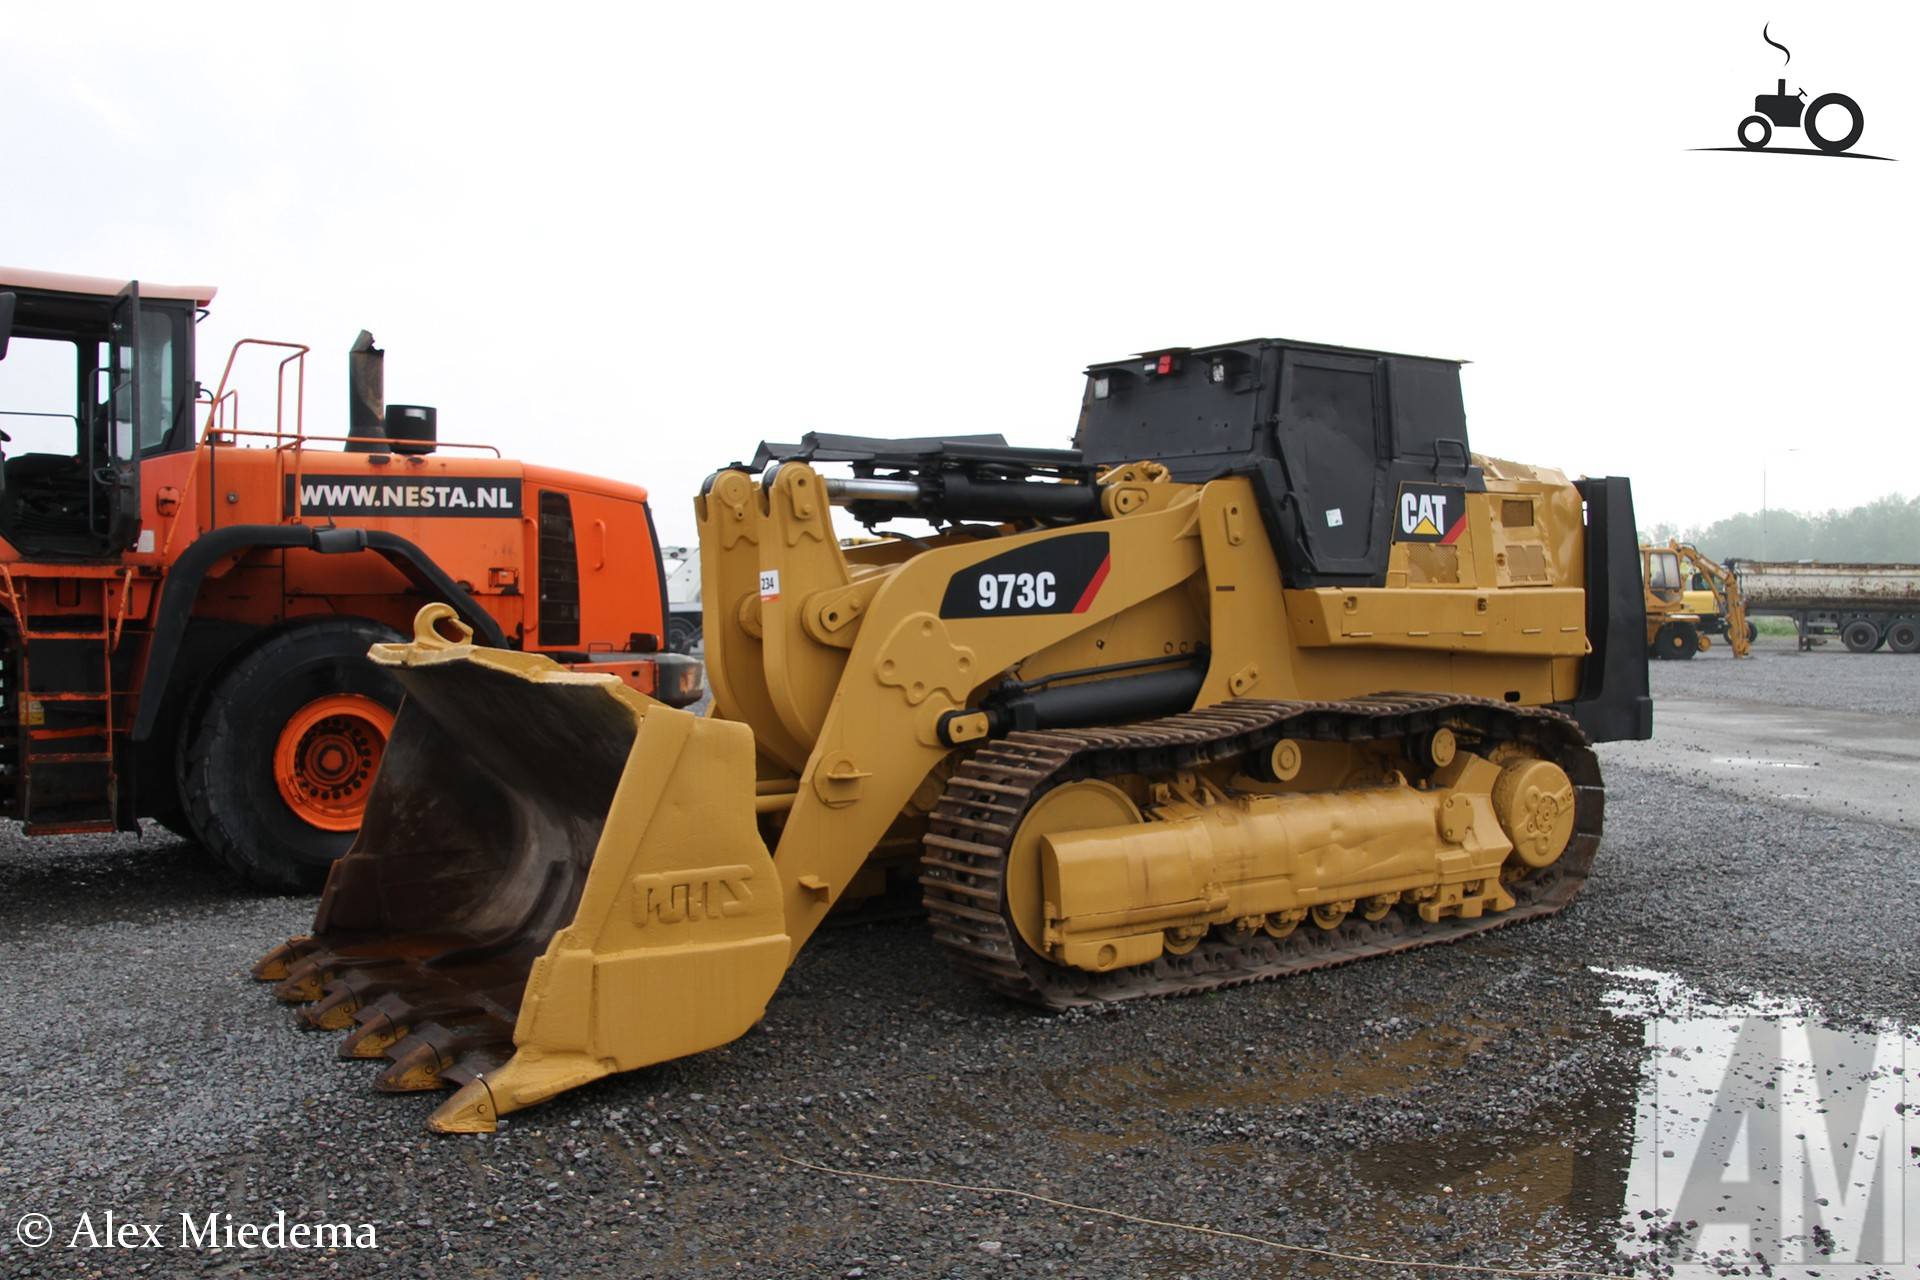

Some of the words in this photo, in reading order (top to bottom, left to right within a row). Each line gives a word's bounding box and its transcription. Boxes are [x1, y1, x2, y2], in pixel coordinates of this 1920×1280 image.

[300, 484, 513, 508] WWW.NESTA.NL
[1401, 493, 1446, 535] CAT
[761, 577, 774, 590] 234
[979, 571, 1056, 610] 973C
